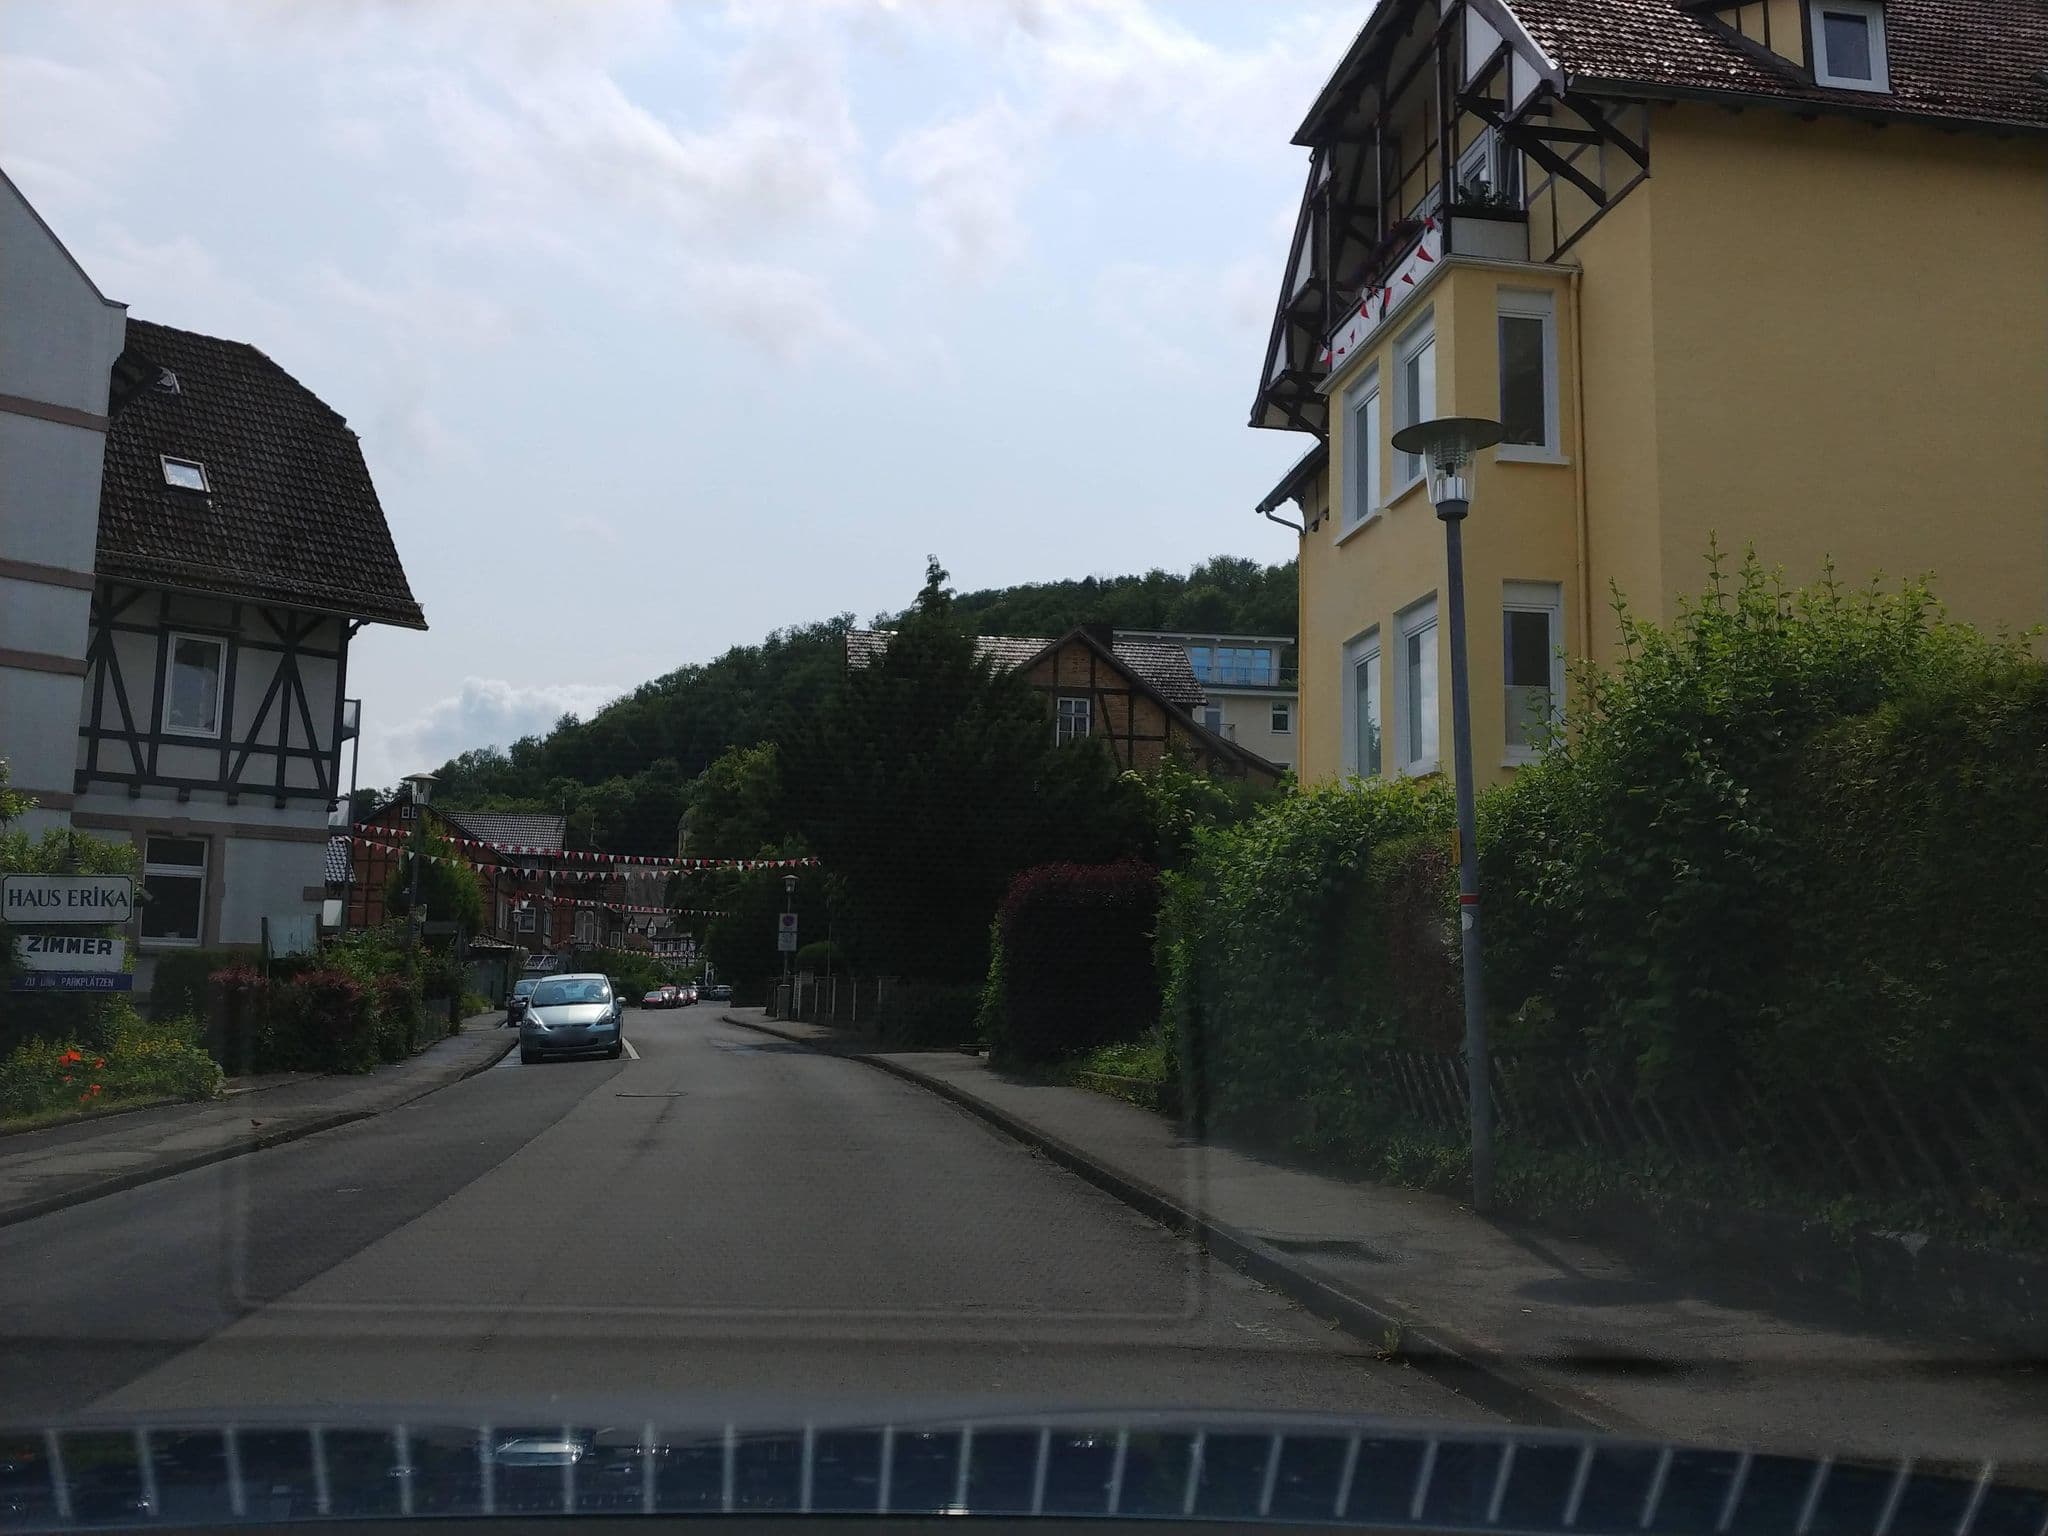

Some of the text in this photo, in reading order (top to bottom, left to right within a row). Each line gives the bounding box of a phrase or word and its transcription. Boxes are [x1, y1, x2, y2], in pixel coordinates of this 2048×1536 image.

[8, 888, 61, 907] HAUS
[26, 936, 113, 956] ZIMMER
[61, 976, 114, 988] PARKPLÄTZEN
